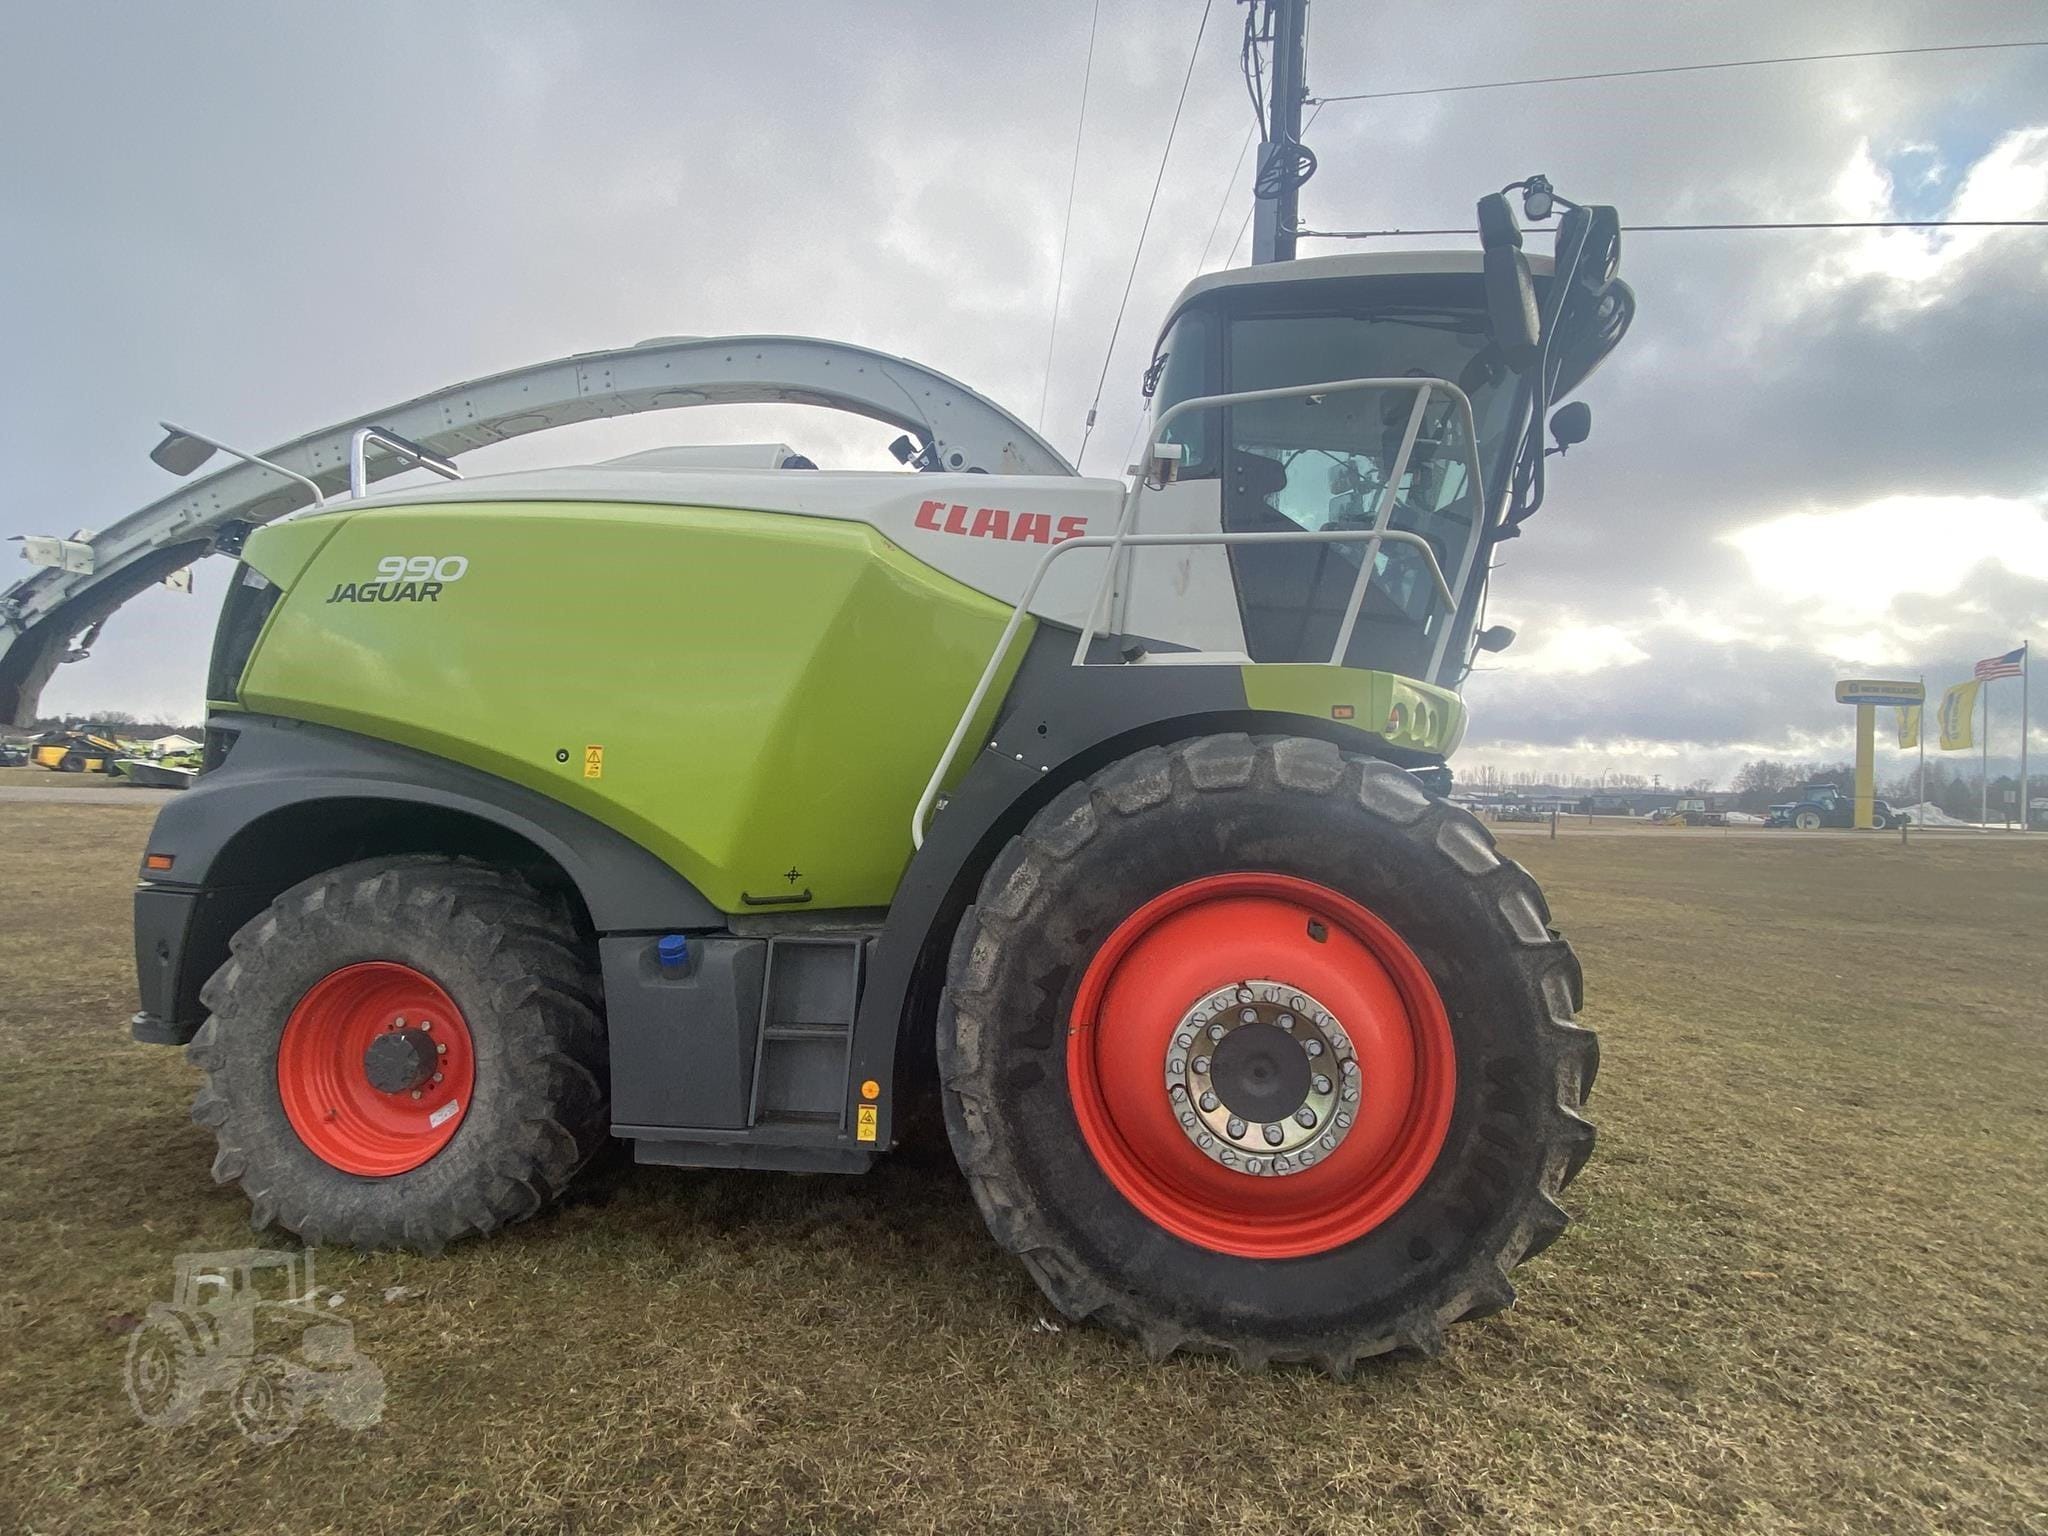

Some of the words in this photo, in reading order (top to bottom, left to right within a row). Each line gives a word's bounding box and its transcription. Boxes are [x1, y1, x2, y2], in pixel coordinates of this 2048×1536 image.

[914, 500, 1089, 545] CLAAS
[375, 556, 469, 582] 990
[325, 582, 443, 604] JAGUAR
